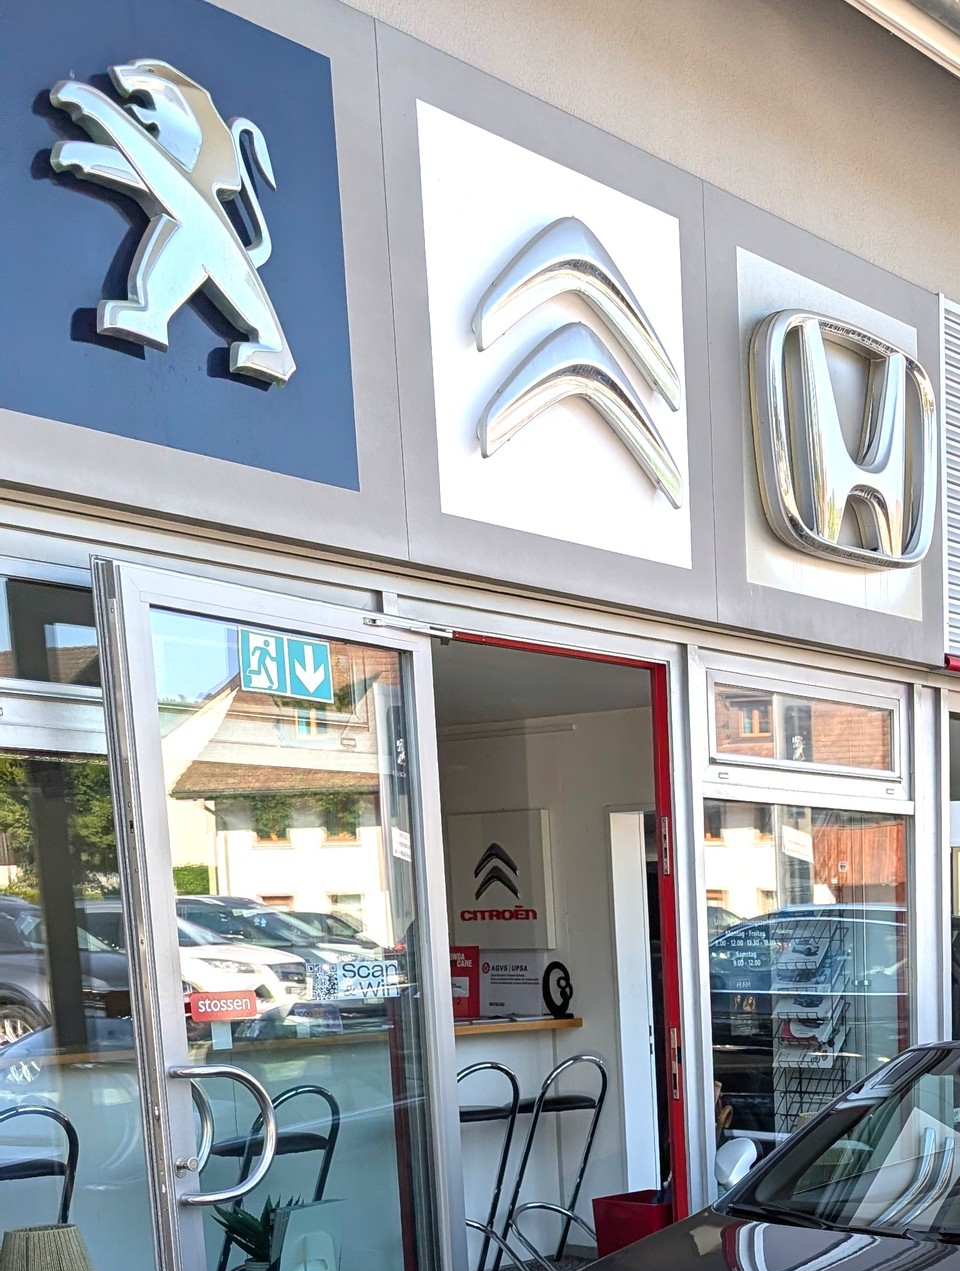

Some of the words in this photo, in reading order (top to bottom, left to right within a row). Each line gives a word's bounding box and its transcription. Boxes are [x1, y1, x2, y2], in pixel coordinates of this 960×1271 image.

[748, 930, 766, 938] Freitag
[736, 951, 757, 959] Samstag
[456, 959, 473, 968] CARE
[491, 963, 508, 972] AGVS
[511, 963, 528, 972] UPSA
[342, 963, 398, 979] Scan
[359, 981, 400, 998] Win
[198, 997, 251, 1013] stossen
